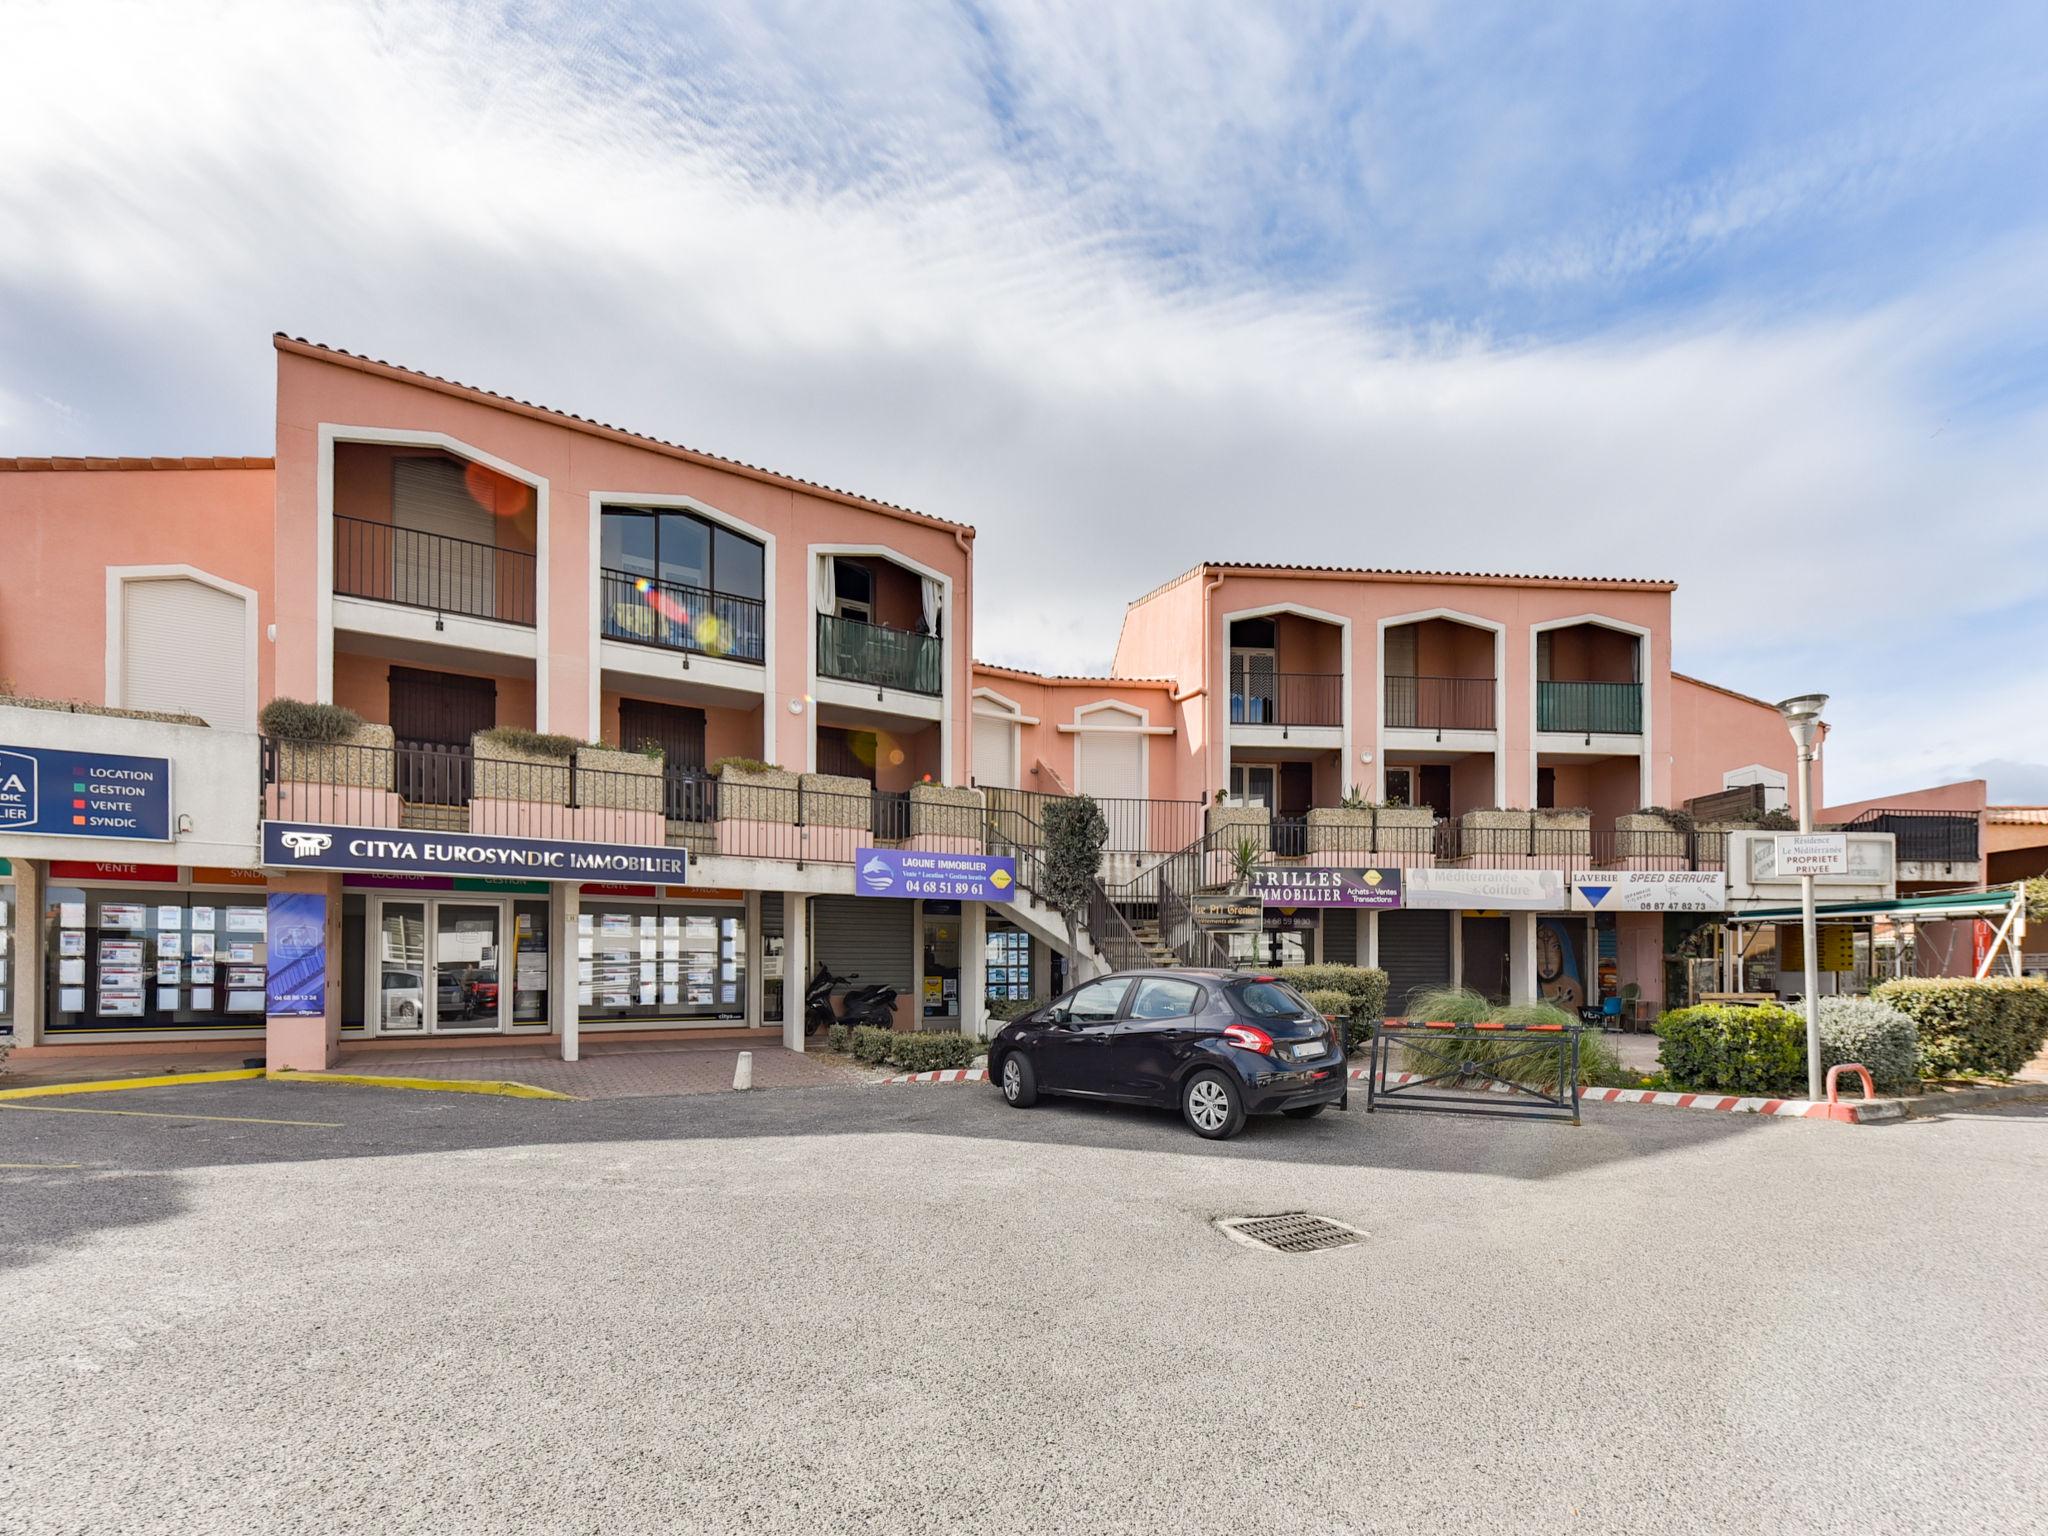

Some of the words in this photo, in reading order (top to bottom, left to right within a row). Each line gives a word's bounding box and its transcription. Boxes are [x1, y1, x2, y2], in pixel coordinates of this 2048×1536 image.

[89, 768, 154, 781] LOCATION
[89, 784, 146, 797] GESTION
[91, 800, 133, 812] VENTE
[89, 816, 137, 828] SYNDIC
[349, 839, 418, 860] CITYA
[424, 844, 564, 867] EUROSYNDIC
[571, 854, 682, 874] IMMOBILIER
[1786, 855, 1839, 864] PROPRIETE
[96, 862, 137, 874] VENTE
[938, 860, 986, 871] IMMOBILIER
[1796, 865, 1830, 873] PRIVEE
[1253, 872, 1342, 886] TRILLES
[1573, 874, 1618, 882] LAVERIE
[1629, 873, 1665, 883] SPEED
[1667, 873, 1718, 883] SERRURE
[906, 880, 920, 893] 04
[923, 881, 936, 893] 68
[940, 882, 952, 894] 51
[955, 882, 969, 895] 89
[971, 883, 984, 896] 61
[1347, 887, 1370, 895] Achats
[1375, 888, 1398, 896] Ventes
[1482, 885, 1531, 896] Coiffure
[1252, 888, 1342, 901] IMMOBILIER
[1353, 896, 1393, 904] Transactions
[1227, 904, 1259, 915] Grenier
[1668, 903, 1679, 911] 47
[1695, 903, 1706, 911] 73
